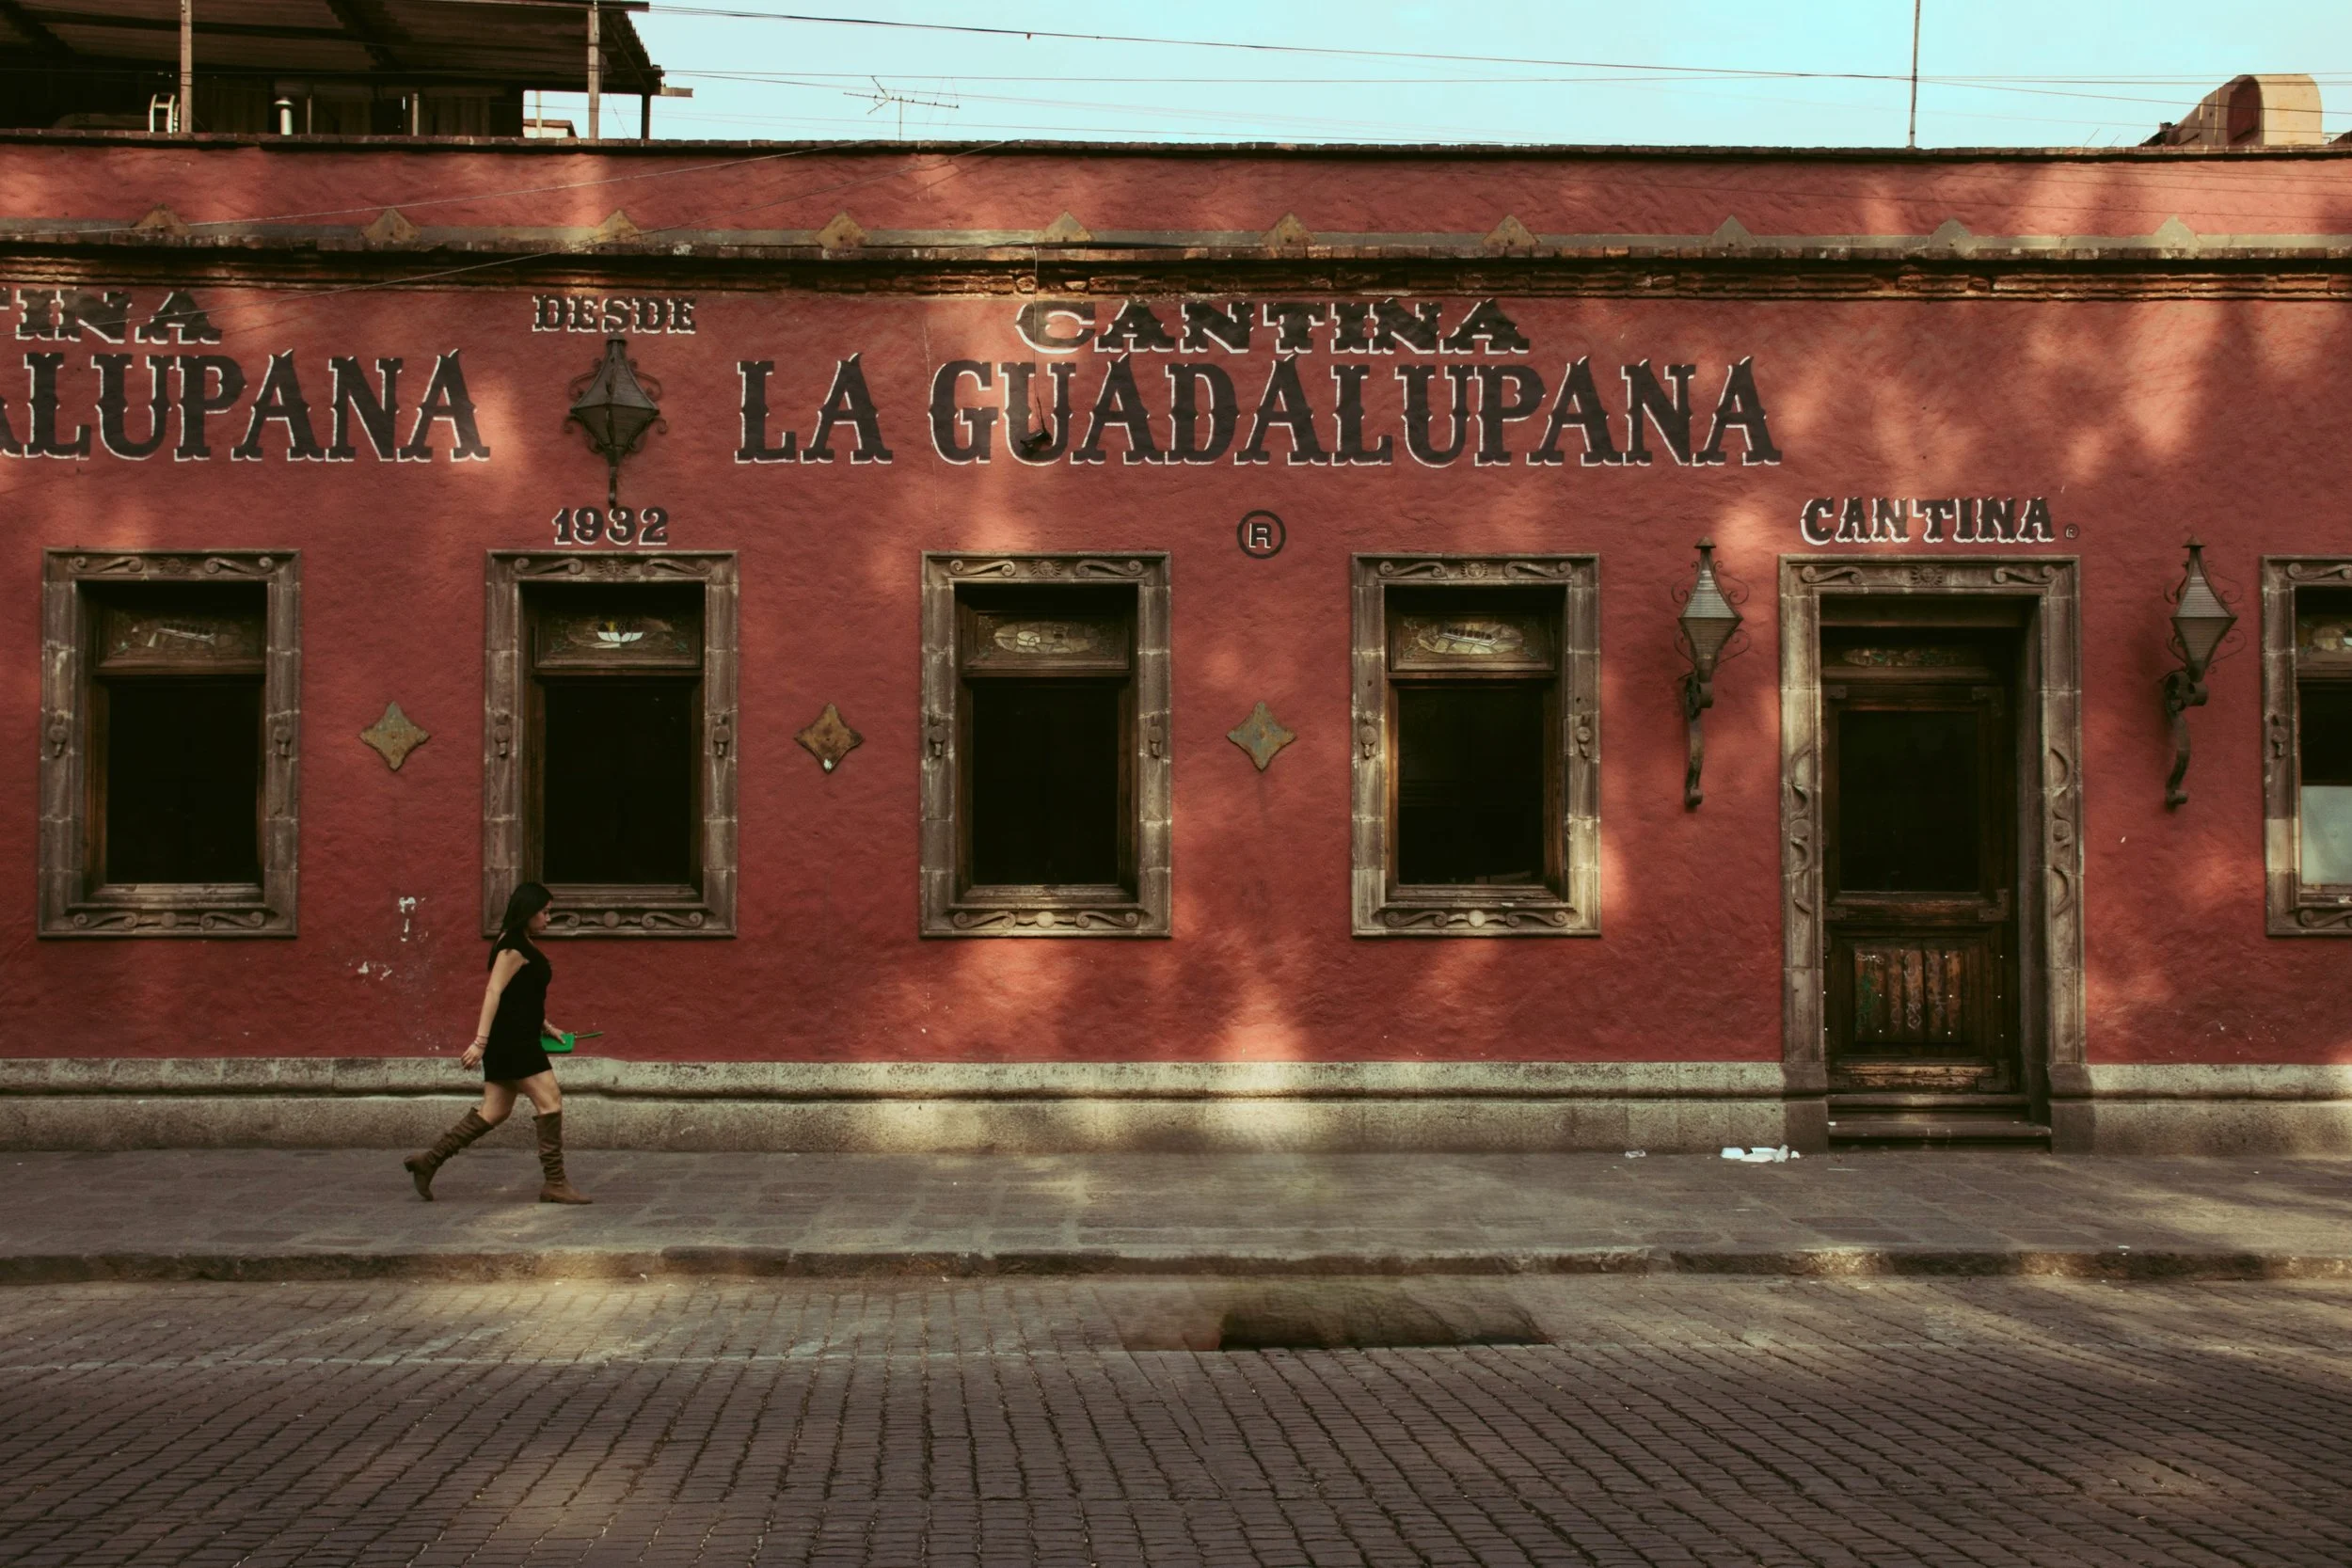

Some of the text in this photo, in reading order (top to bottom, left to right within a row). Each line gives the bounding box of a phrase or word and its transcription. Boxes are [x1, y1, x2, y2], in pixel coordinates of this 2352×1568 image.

[0, 288, 222, 344] INA
[532, 295, 696, 334] DESDE
[1014, 296, 1530, 354] CANTINA
[0, 350, 490, 462] LUPANA
[735, 353, 1782, 467] LA GUADALUPANA
[551, 507, 669, 546] 1932
[1800, 497, 2055, 546] CANTINA
